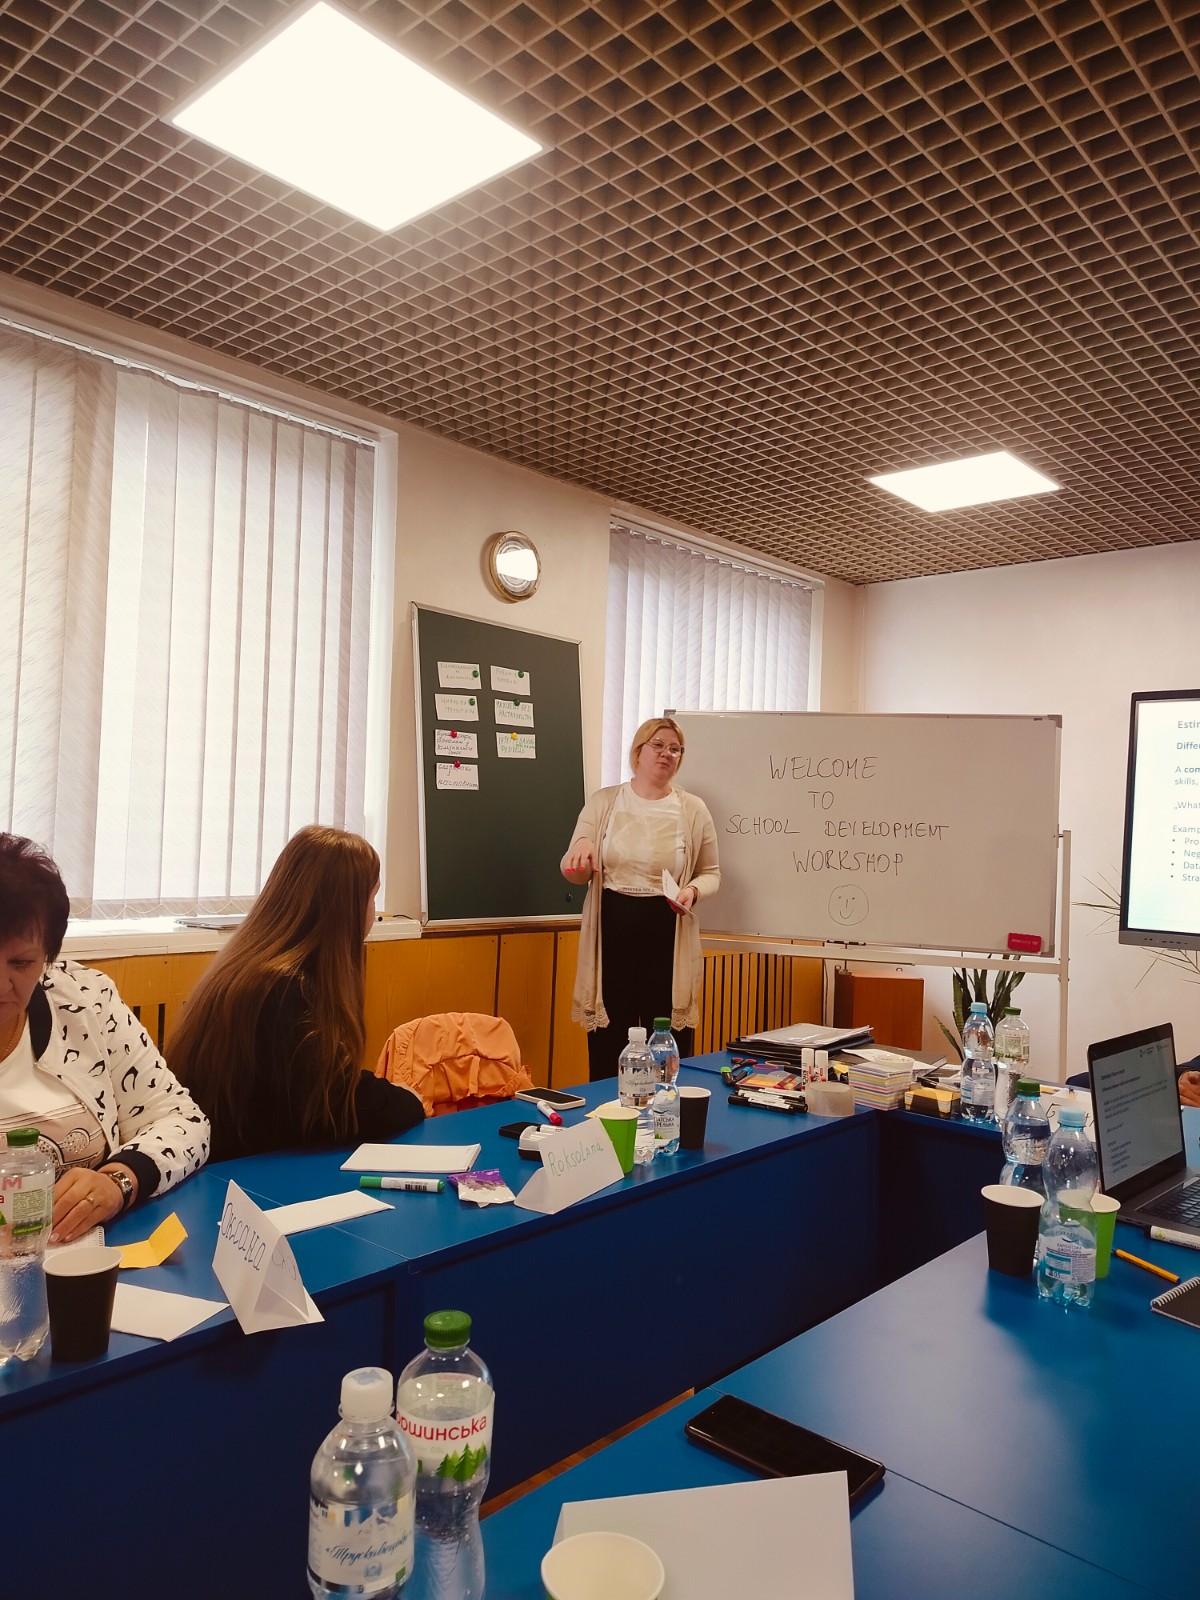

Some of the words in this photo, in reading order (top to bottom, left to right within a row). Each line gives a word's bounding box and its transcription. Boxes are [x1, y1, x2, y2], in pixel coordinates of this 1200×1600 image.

[769, 754, 878, 779] WELCOME
[1175, 765, 1181, 773] A
[808, 791, 834, 810] TO
[725, 814, 801, 835] SCHOOL
[824, 820, 950, 840] DEVELOPMENT
[793, 849, 904, 876] WORKSHOP
